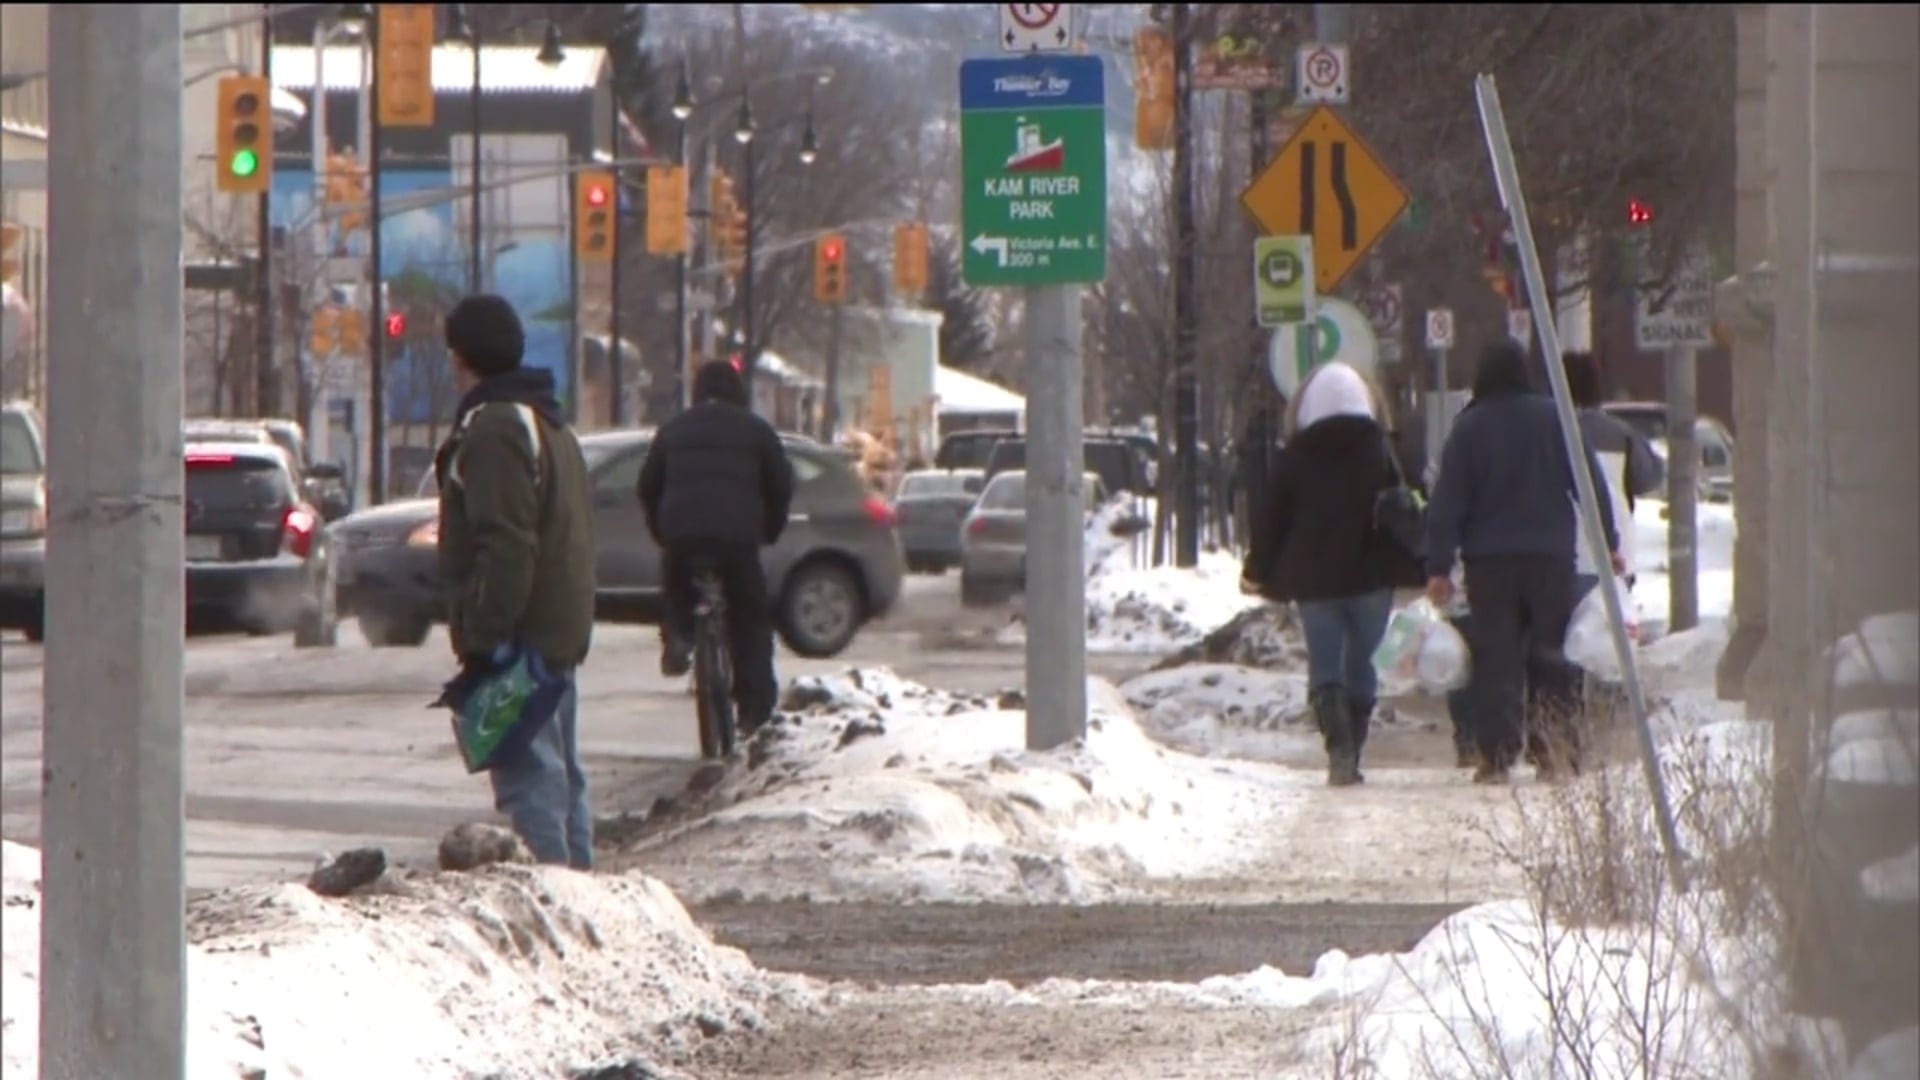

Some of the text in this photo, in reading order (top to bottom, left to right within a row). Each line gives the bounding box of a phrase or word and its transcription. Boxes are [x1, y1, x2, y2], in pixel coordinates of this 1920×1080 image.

[984, 176, 1080, 196] KAM RIVER
[1010, 202, 1054, 219] PARK
[1010, 236, 1054, 250] Victoria
[1641, 324, 1709, 342] SIGNAL
